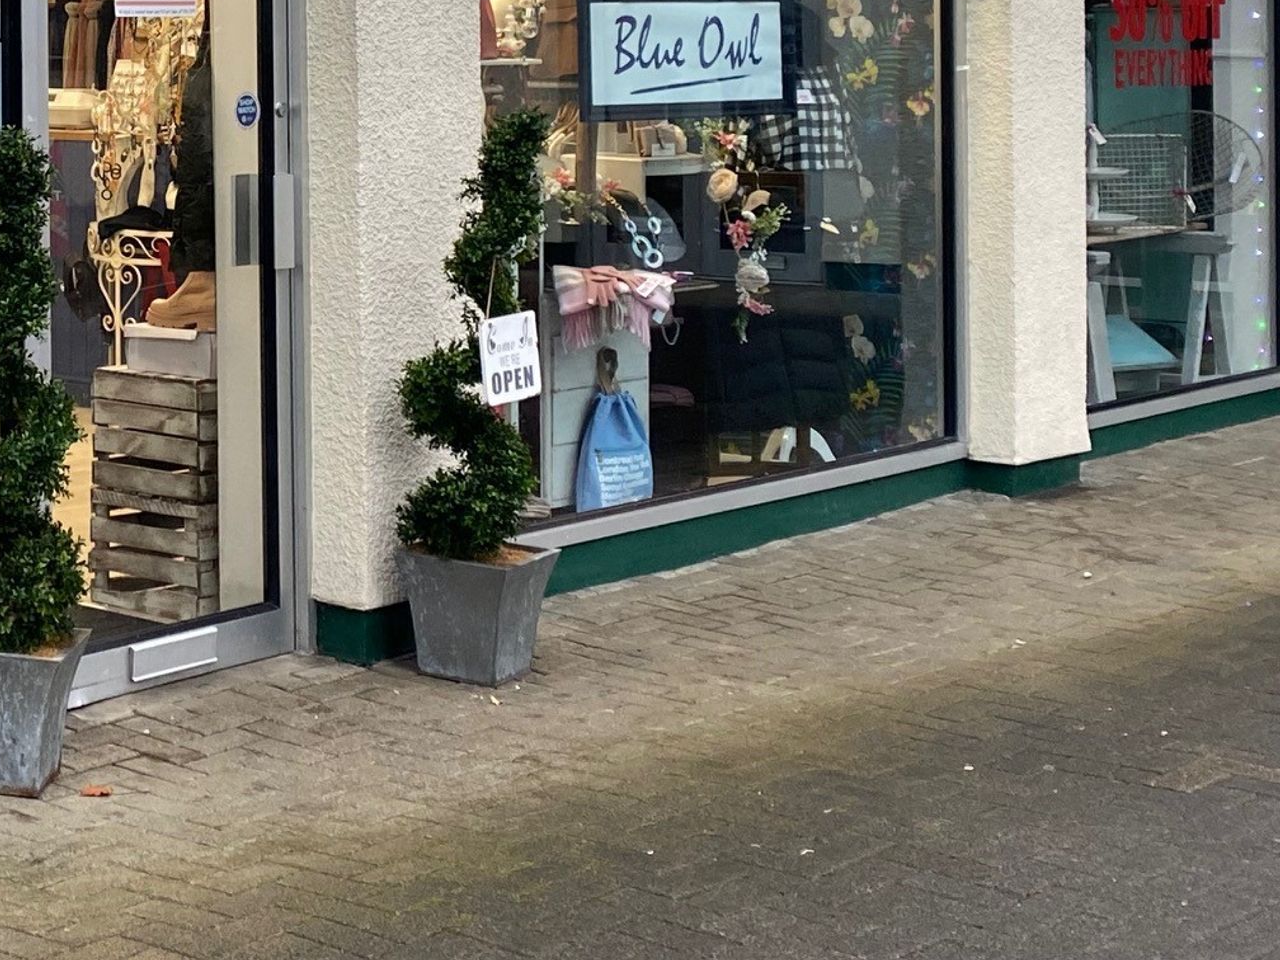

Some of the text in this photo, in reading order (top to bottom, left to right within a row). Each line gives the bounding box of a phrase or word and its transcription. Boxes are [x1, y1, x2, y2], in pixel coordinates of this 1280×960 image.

[614, 12, 763, 75] Blue Owl
[491, 365, 535, 395] OPEN
